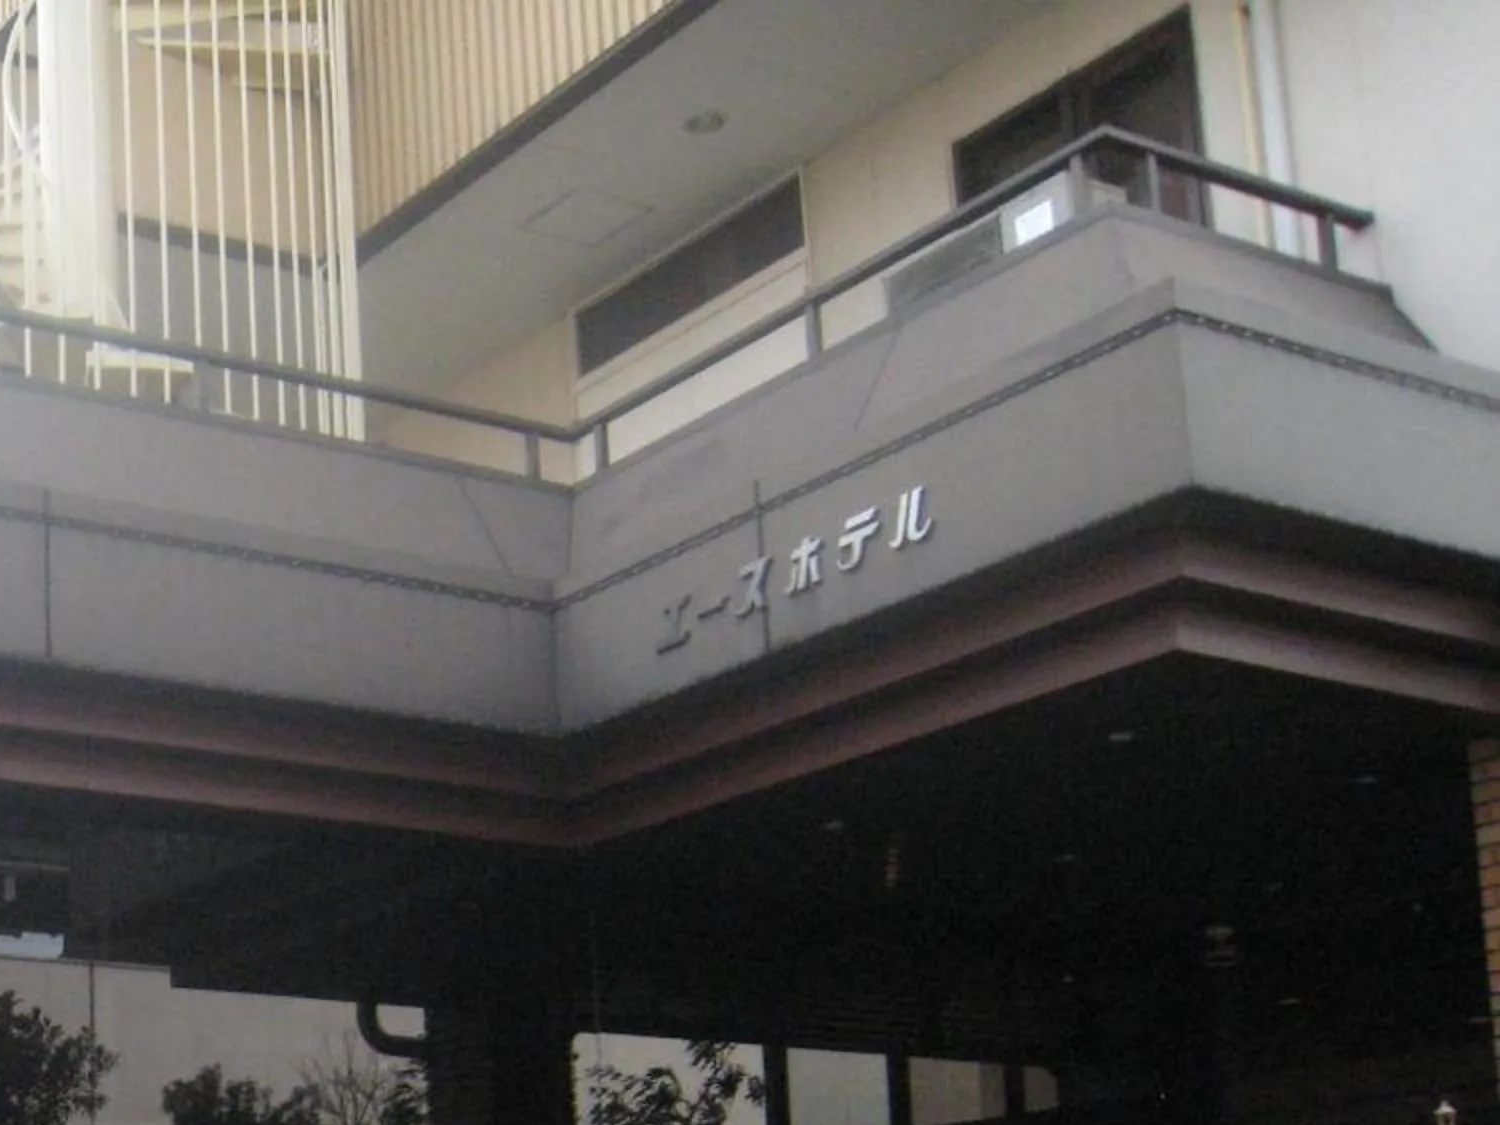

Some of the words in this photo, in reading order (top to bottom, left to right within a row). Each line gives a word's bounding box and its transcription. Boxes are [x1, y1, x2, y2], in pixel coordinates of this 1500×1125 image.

[655, 484, 933, 656] エースホテル
